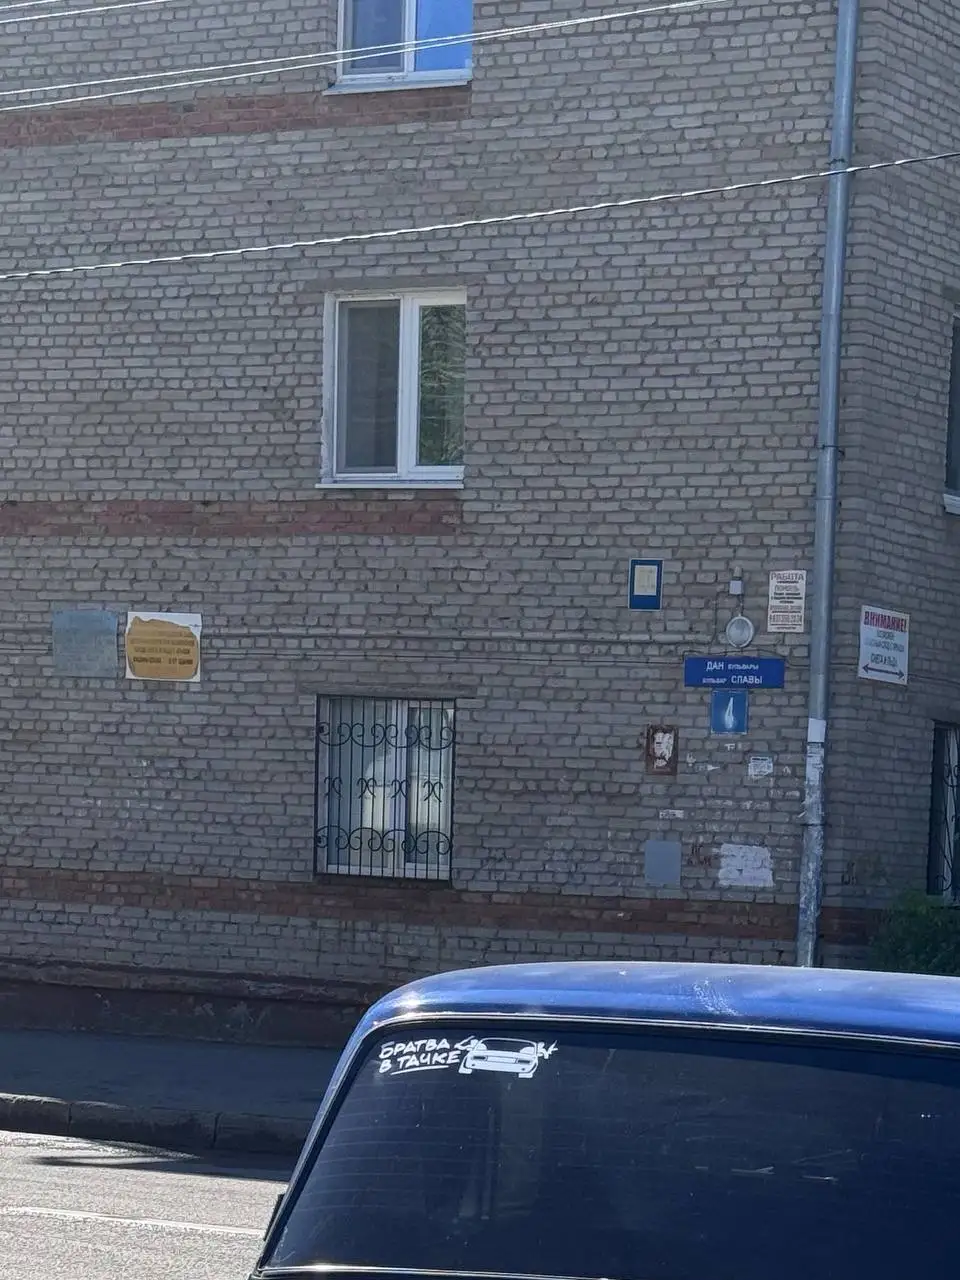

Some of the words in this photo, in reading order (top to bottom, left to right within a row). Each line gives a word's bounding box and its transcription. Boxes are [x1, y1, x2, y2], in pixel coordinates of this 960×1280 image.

[864, 611, 907, 633] ВНИМАНИЕ!
[706, 661, 724, 671] ДАН
[730, 675, 763, 684] СЛАВЫ
[379, 1038, 450, 1059] БРАТВА
[379, 1060, 392, 1074] В
[399, 1051, 461, 1070] ТАЧКЕ
